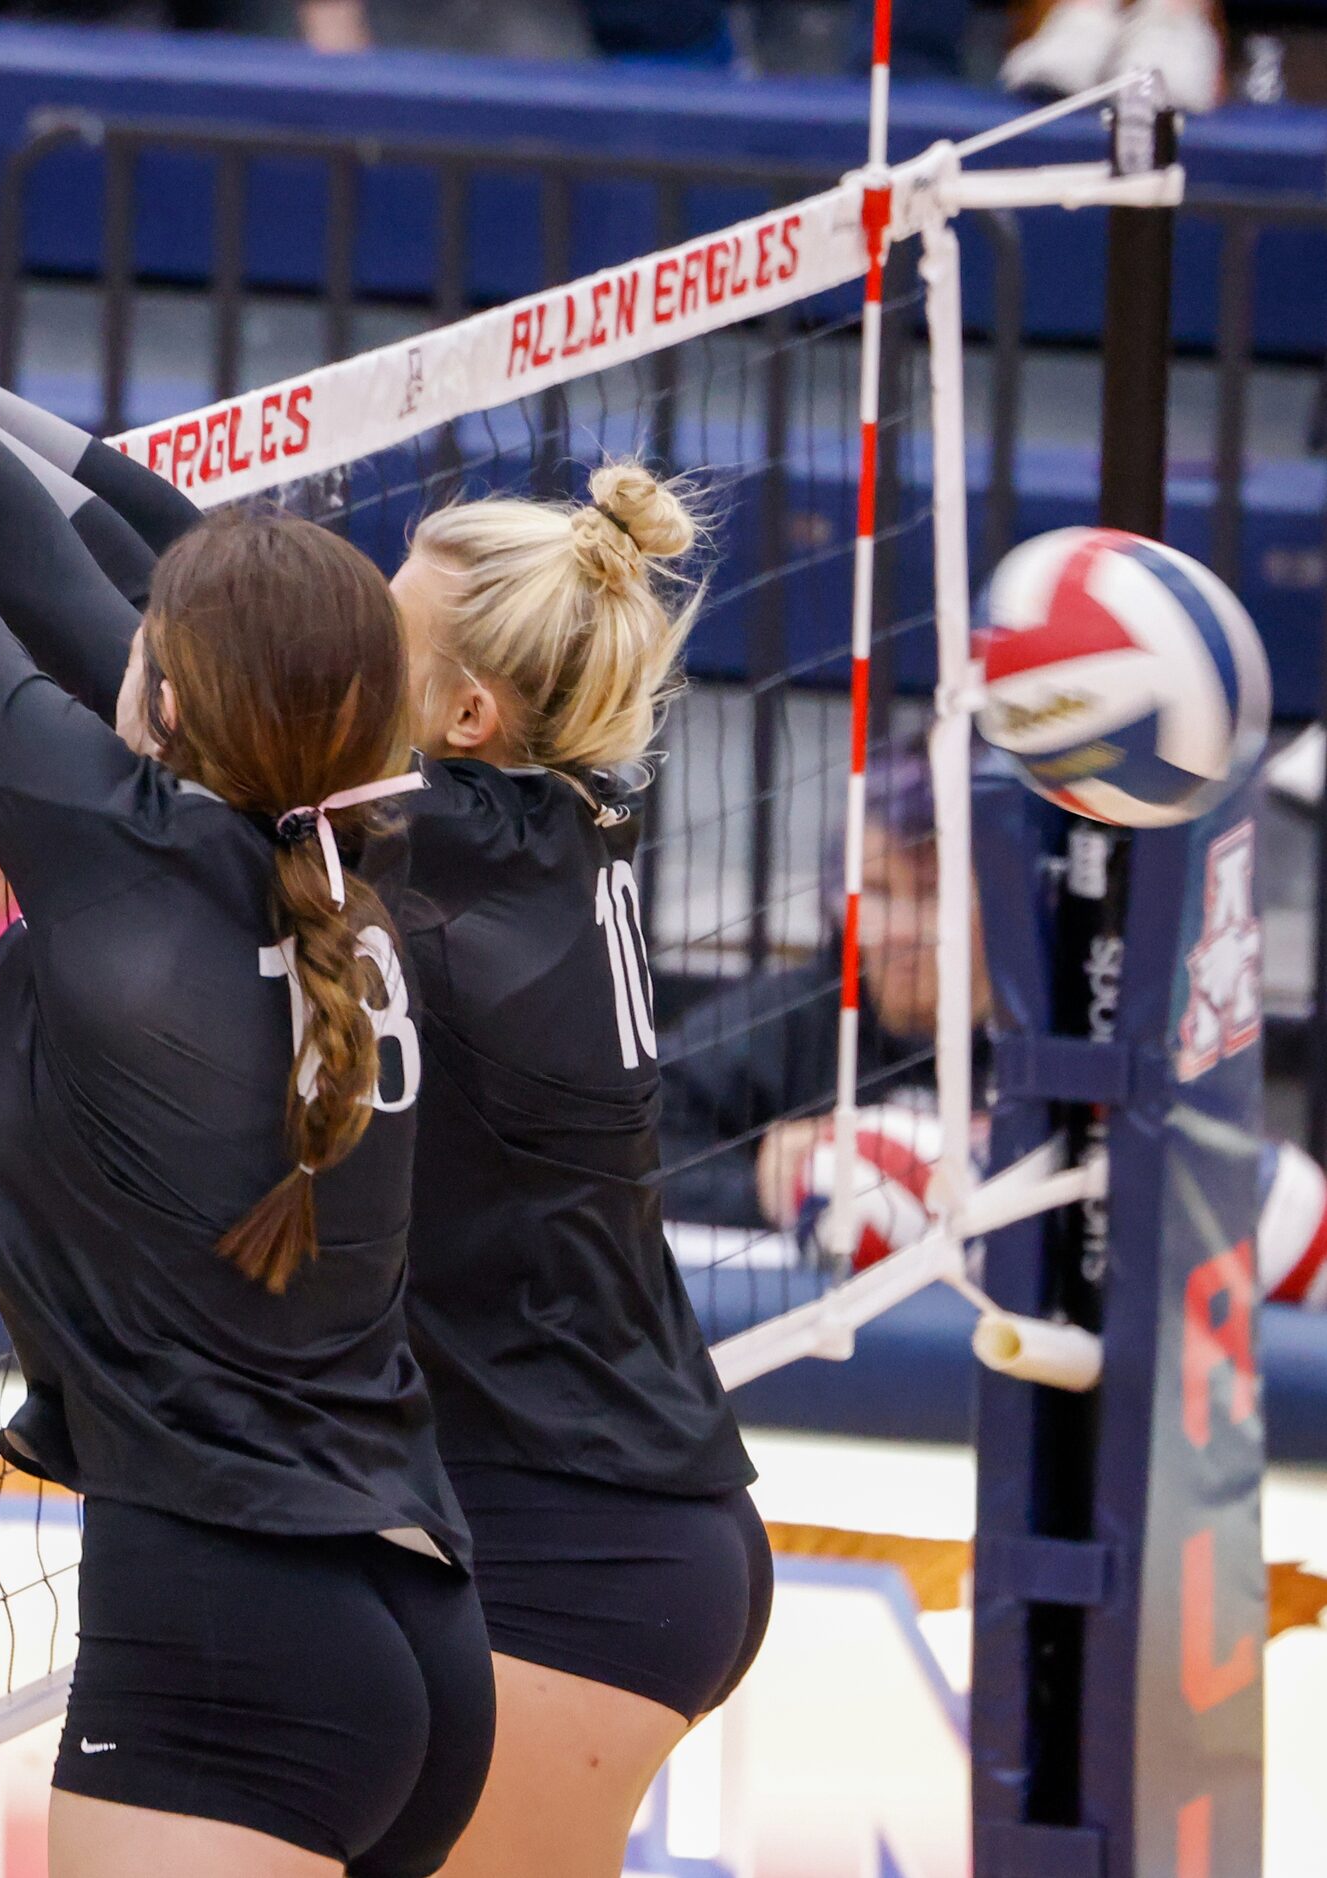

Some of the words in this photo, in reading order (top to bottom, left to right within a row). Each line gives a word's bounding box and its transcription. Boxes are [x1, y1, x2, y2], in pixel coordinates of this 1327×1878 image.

[506, 270, 640, 378] ALLEN
[652, 215, 802, 327] EAGLES
[148, 385, 313, 488] EAGLES
[594, 858, 659, 1070] 10
